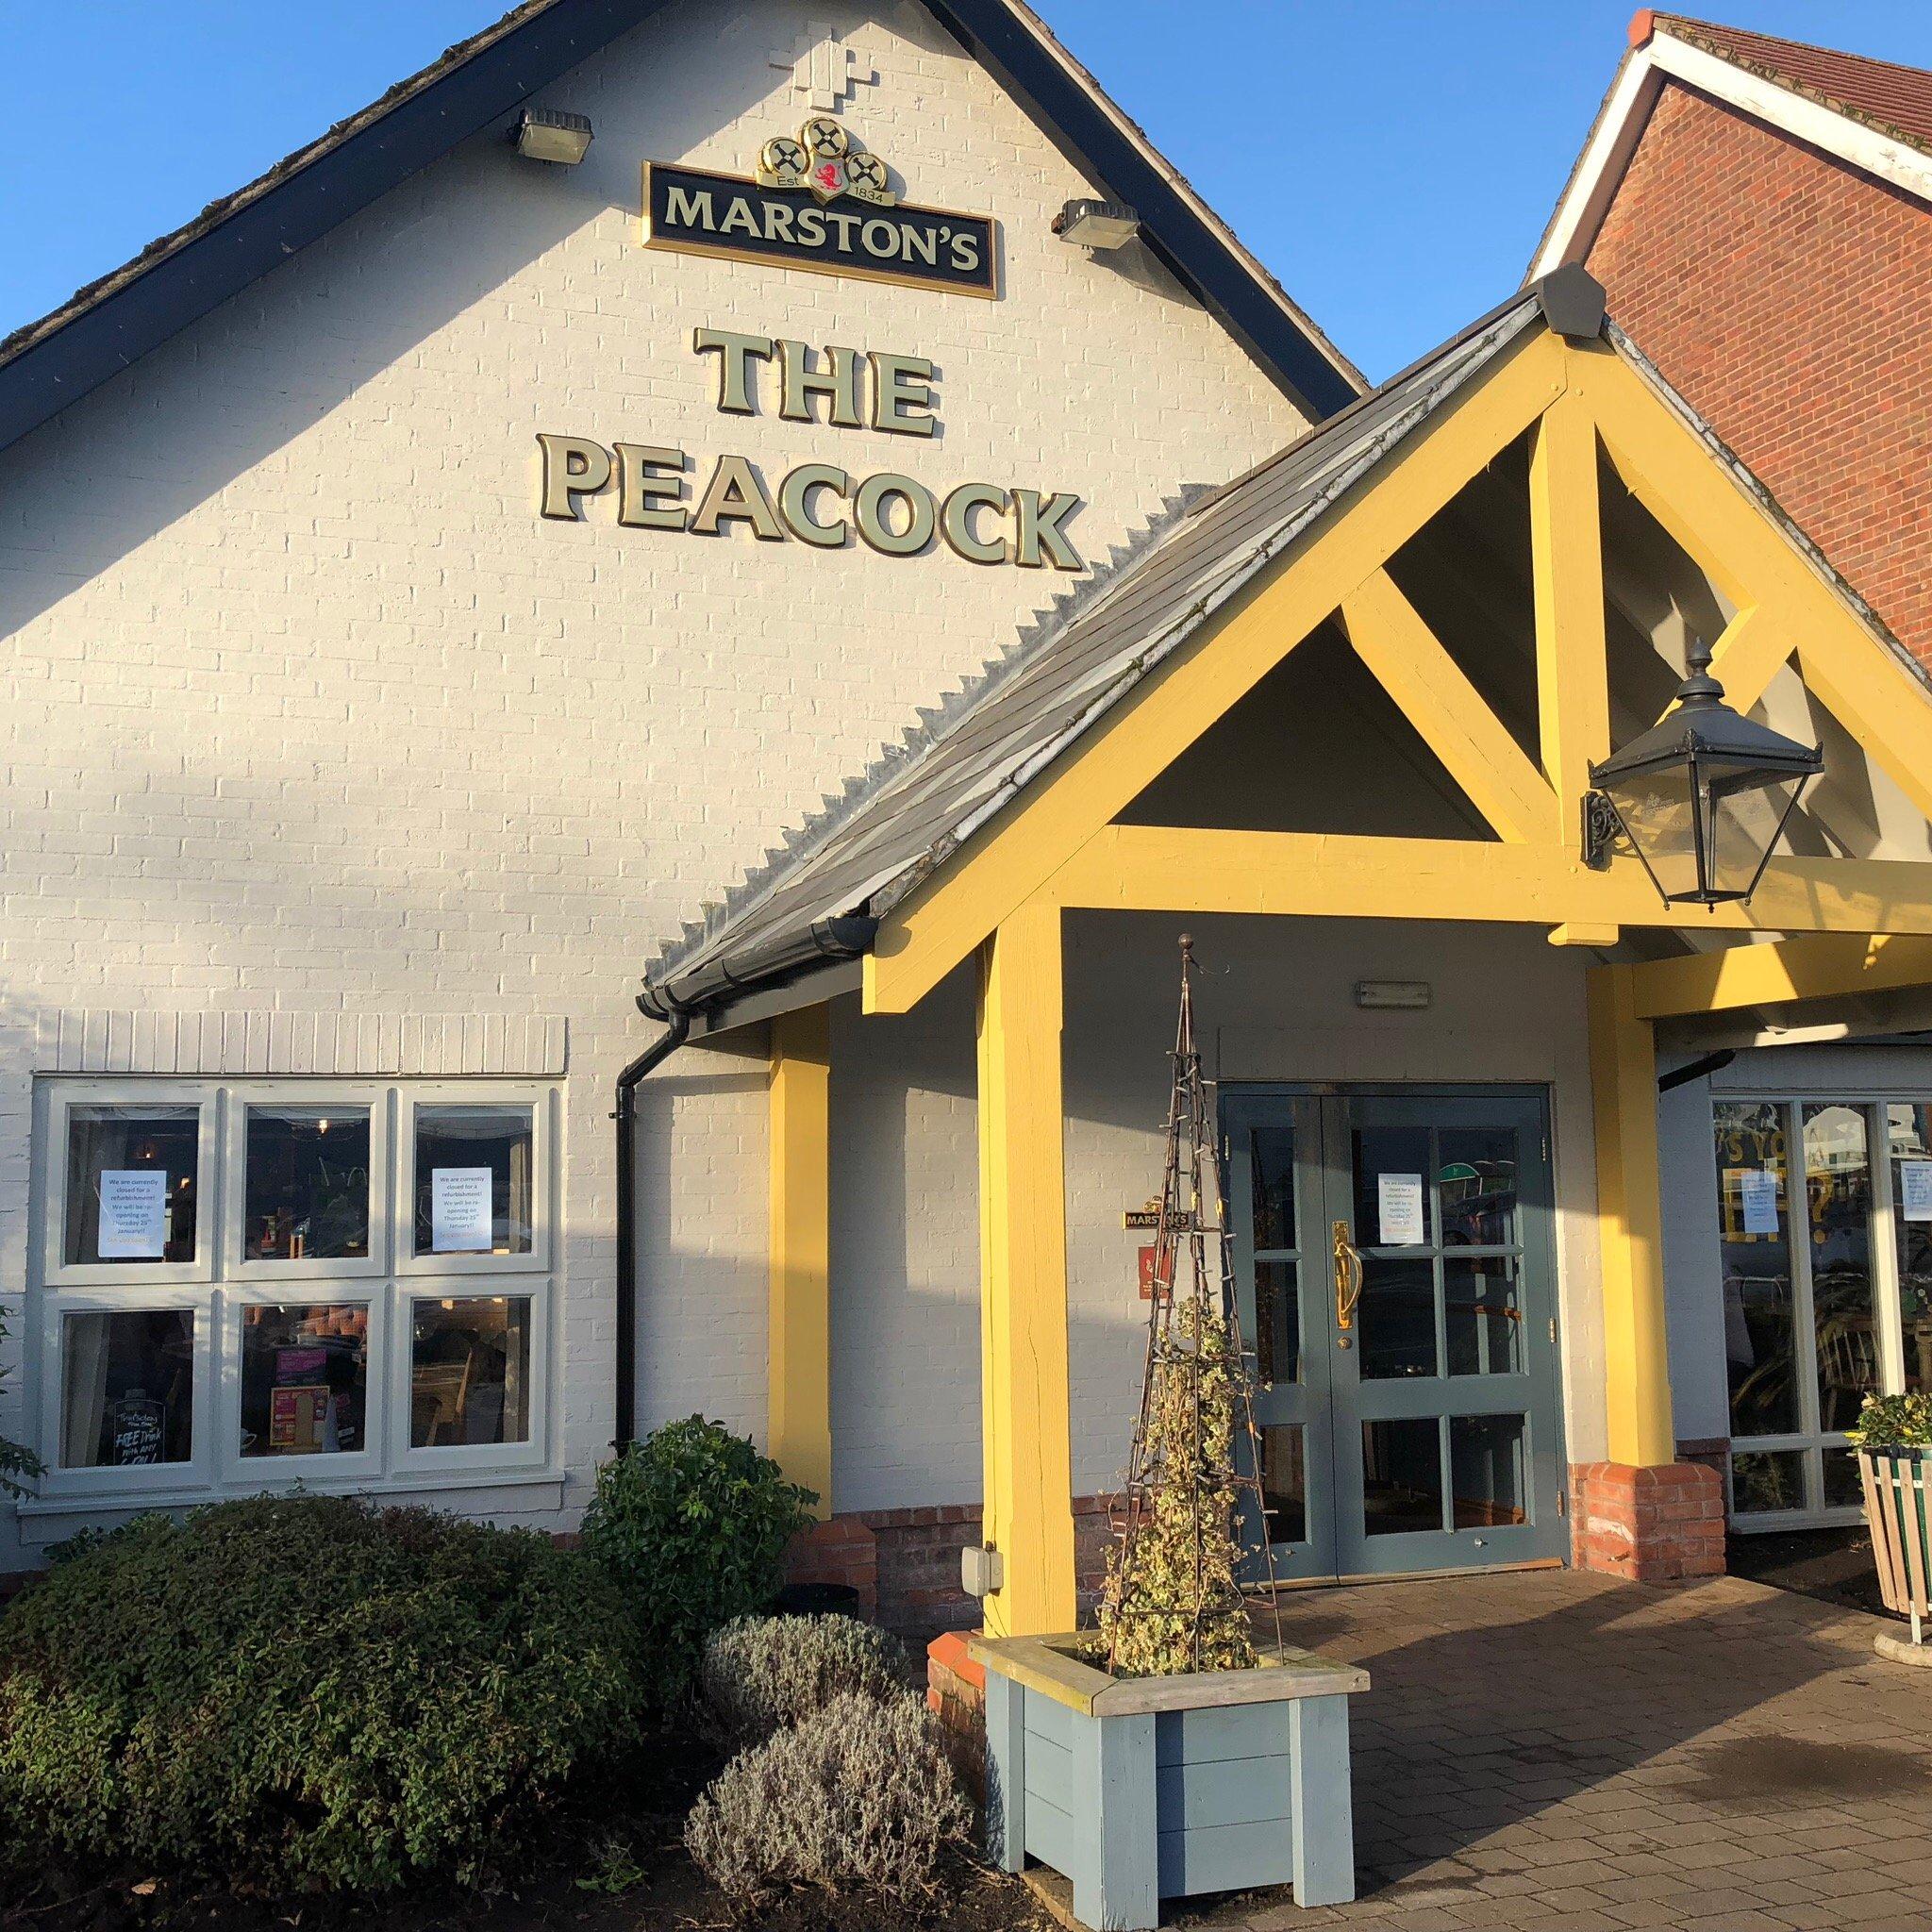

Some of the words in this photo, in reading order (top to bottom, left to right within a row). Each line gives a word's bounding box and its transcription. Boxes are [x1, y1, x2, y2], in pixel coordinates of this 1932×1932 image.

[664, 186, 979, 271] MARSTON'S
[777, 175, 799, 186] Est
[855, 187, 883, 203] 1834
[693, 327, 939, 439] THE
[536, 433, 1083, 573] PEACOCK
